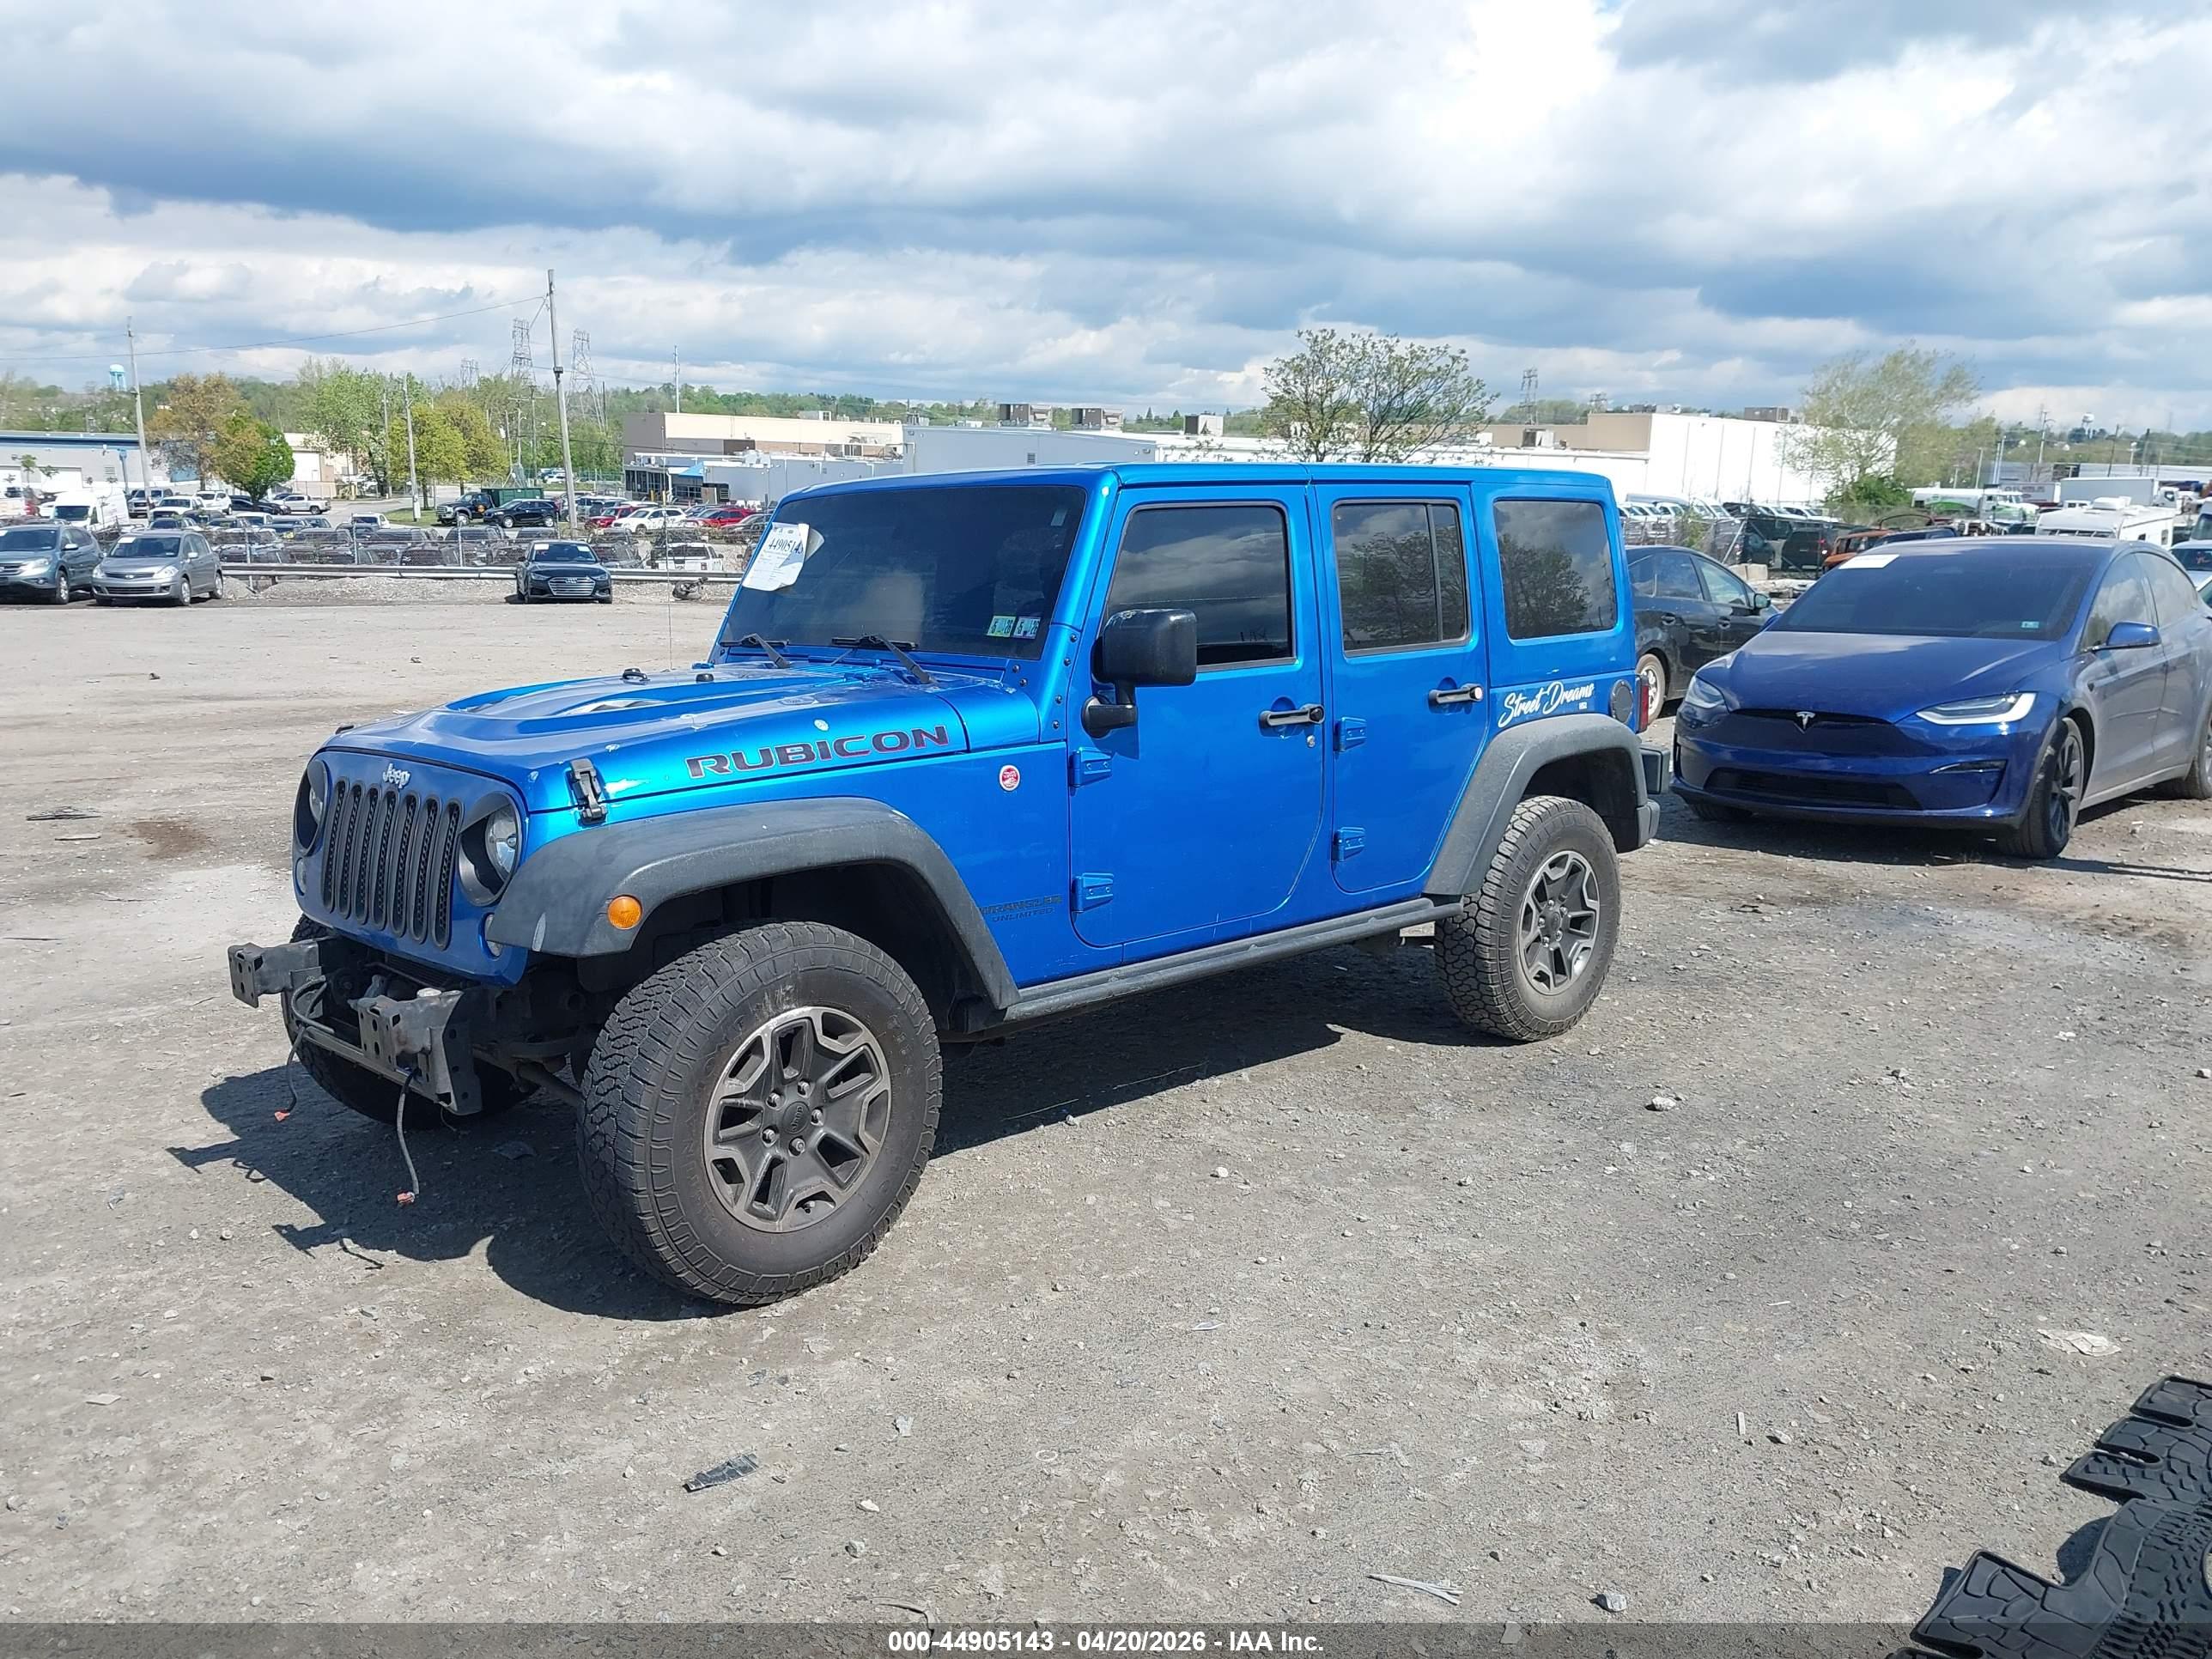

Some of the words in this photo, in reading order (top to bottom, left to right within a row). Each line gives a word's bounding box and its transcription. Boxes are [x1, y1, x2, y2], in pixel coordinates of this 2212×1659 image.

[1498, 686, 1545, 727] Street
[1543, 681, 1595, 714] Dreams
[686, 726, 950, 778] RUBICON
[382, 763, 410, 788] Jeep
